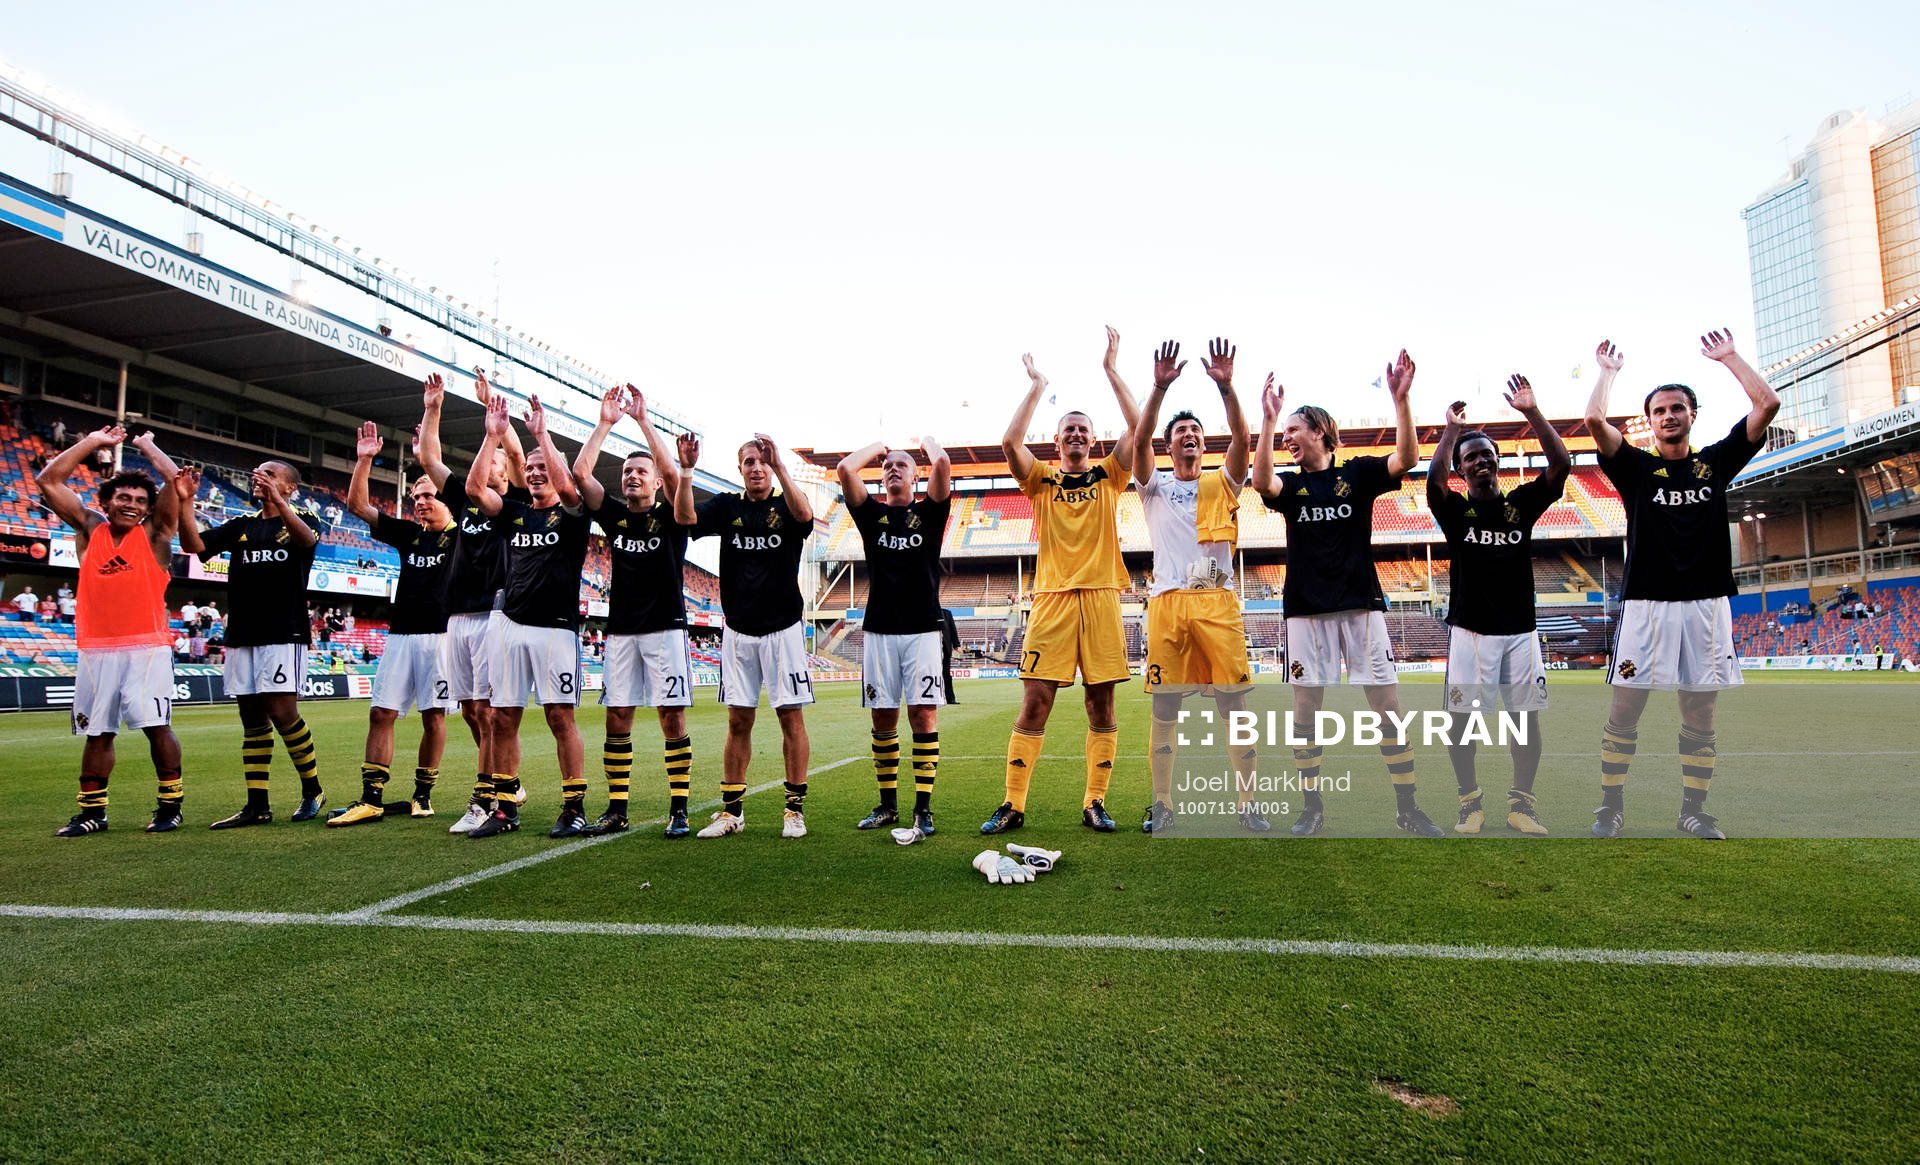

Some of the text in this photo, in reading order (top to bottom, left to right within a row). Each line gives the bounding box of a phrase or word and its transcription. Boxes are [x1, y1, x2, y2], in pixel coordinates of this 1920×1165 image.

[83, 225, 220, 296] VÄLKOMMEN
[229, 285, 258, 311] TILL
[347, 334, 404, 368] STADION
[1297, 503, 1353, 523] ÅBRO
[613, 534, 661, 553] ÅBRO
[732, 532, 782, 551] ÅBRO
[878, 531, 923, 550] ÅBRO
[1464, 527, 1522, 546] ÅBRO
[242, 549, 288, 564] ÅBRO
[202, 561, 228, 574] SPOR
[272, 663, 287, 684] 6
[559, 672, 574, 694] 8
[788, 670, 811, 696] 14
[979, 669, 1020, 678] Nilfisk-A
[665, 675, 686, 699] 21
